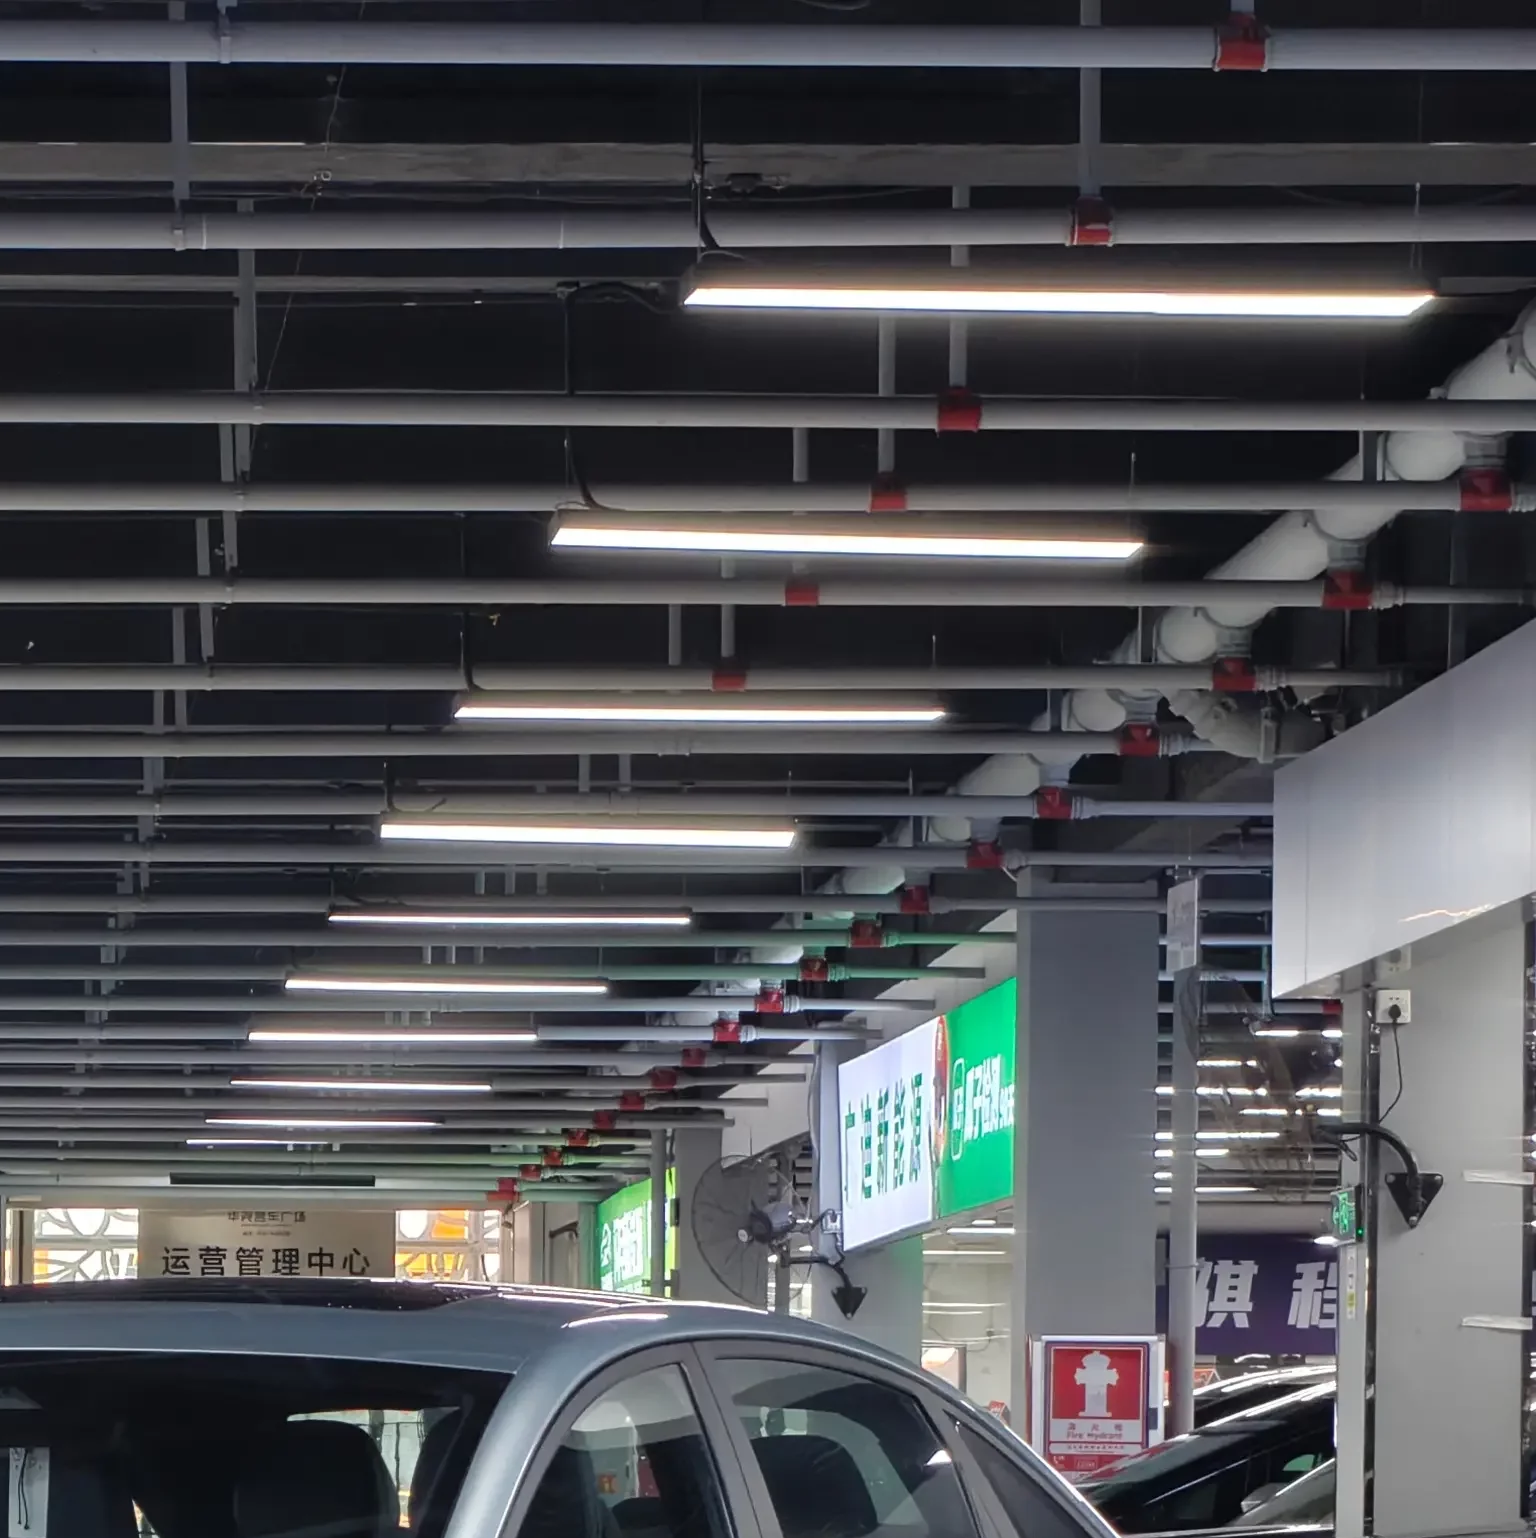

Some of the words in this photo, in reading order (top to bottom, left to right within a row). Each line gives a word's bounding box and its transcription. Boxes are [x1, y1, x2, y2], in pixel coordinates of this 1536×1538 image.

[162, 1246, 371, 1277] 运营管理中心
[1066, 1431, 1084, 1439] Fire
